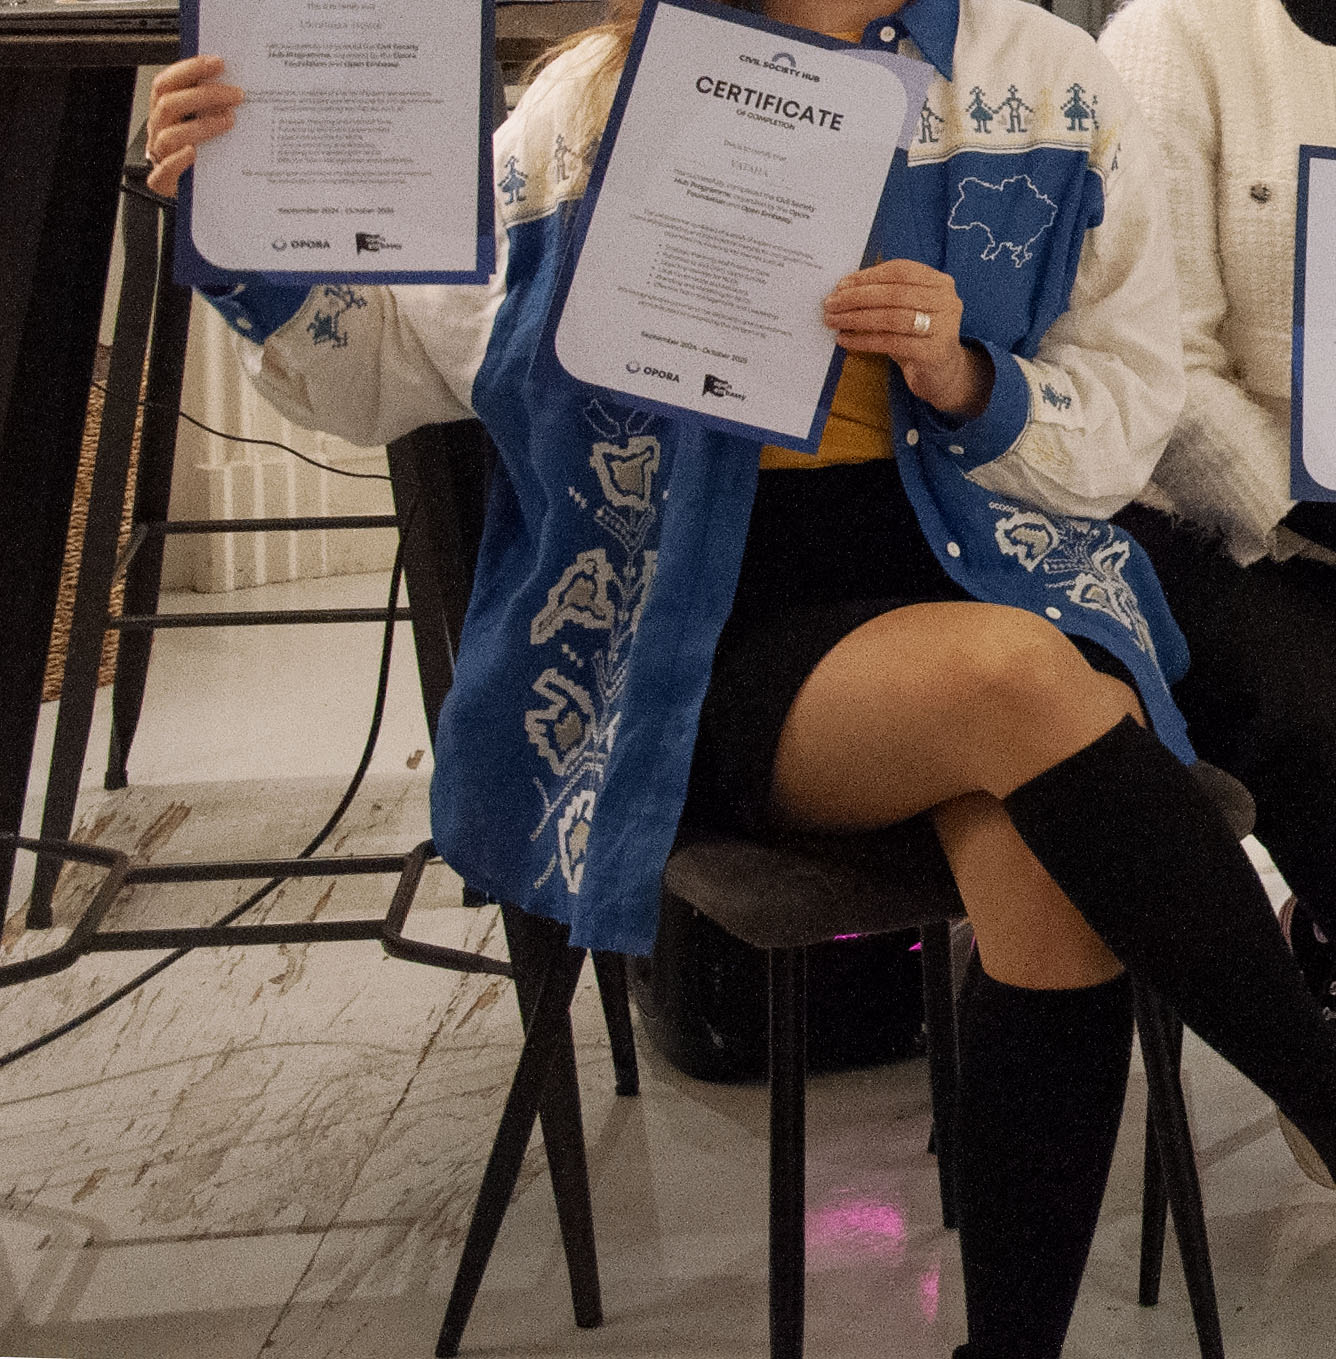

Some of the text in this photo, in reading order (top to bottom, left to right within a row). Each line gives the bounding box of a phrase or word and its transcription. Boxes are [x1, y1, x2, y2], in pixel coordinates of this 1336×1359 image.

[738, 54, 820, 83] CIVIL SOCIETY HUB
[693, 74, 844, 131] CERTIFICATE
[735, 108, 796, 130] OF COMPLETION
[642, 366, 681, 382] OPORA
